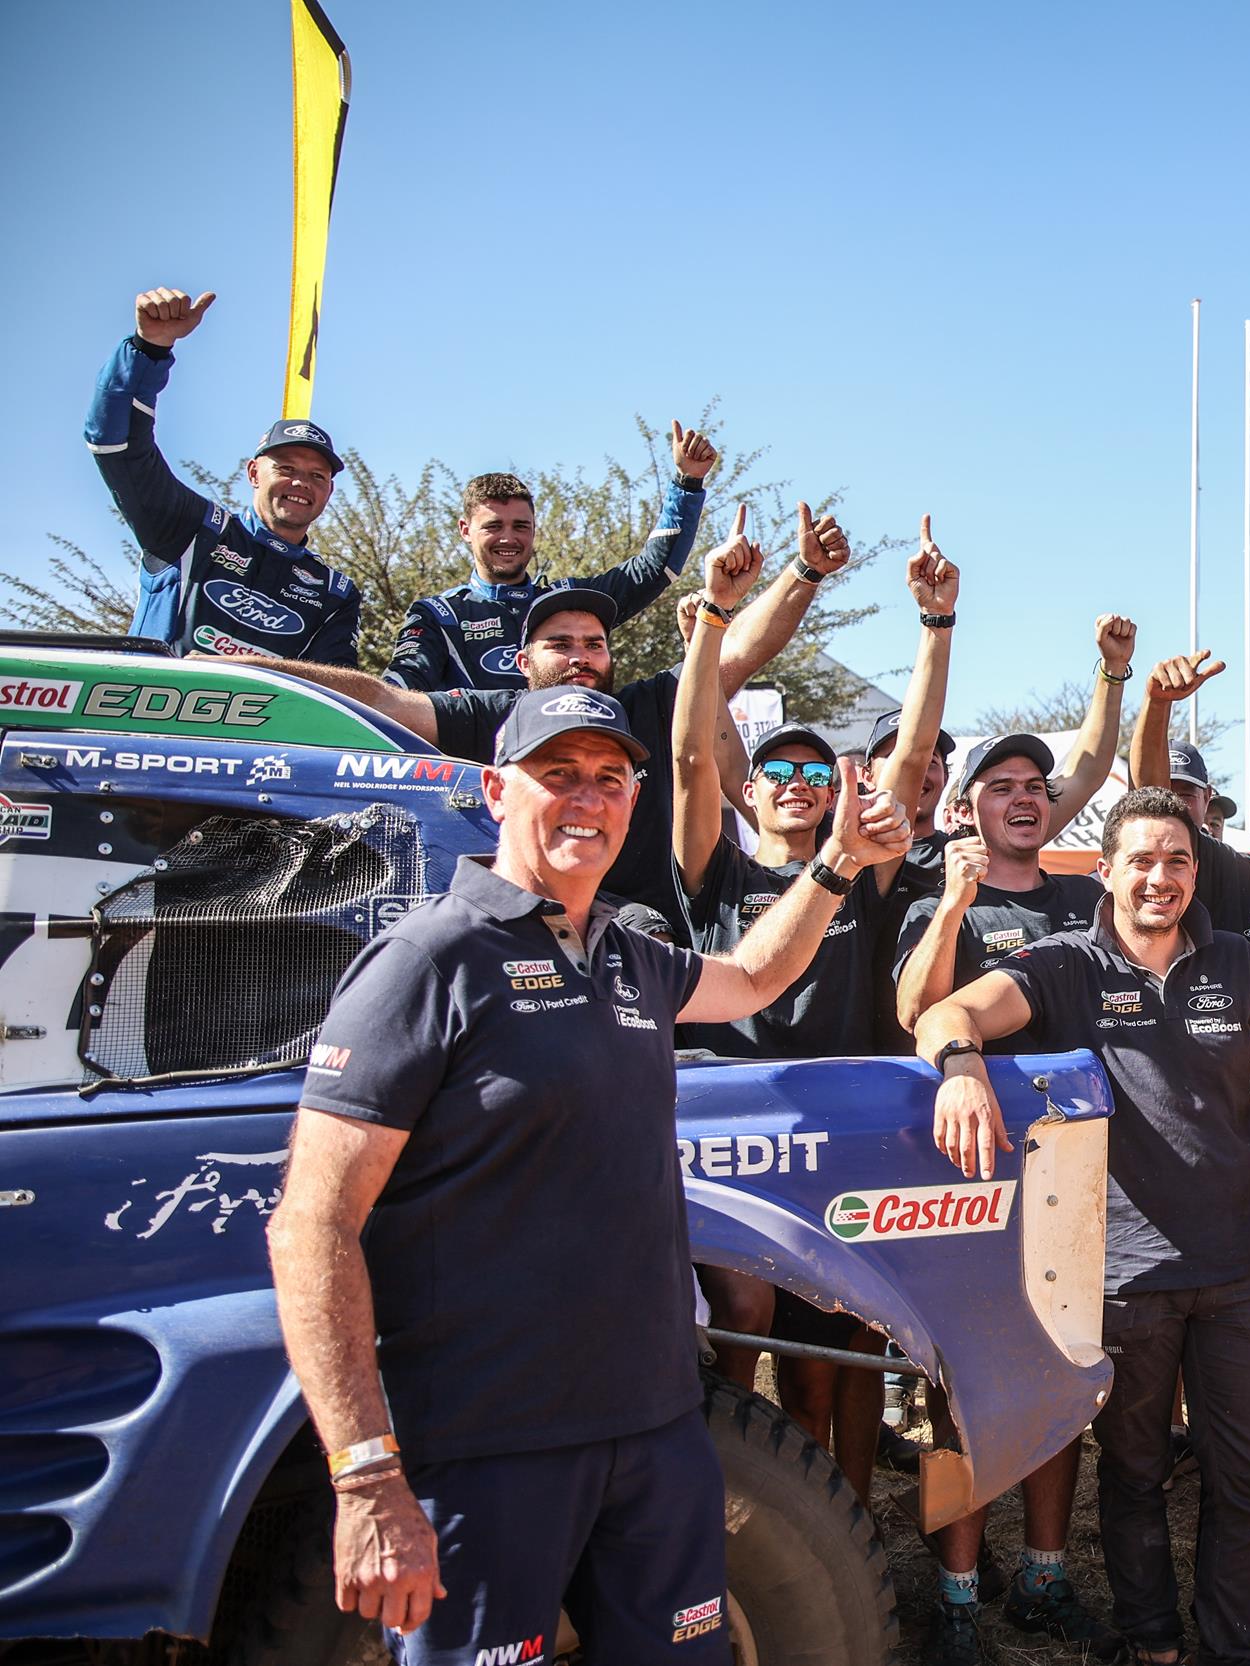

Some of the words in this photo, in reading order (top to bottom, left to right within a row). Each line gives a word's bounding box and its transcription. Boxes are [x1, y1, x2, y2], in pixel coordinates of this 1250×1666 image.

[279, 588, 299, 601] Ford
[219, 587, 289, 631] Ford
[469, 618, 501, 632] Castrol
[464, 628, 504, 642] EDGE
[82, 682, 279, 727] EDGE
[556, 696, 603, 716] Ford
[66, 749, 243, 776] M-SPORT
[336, 753, 454, 782] NWM
[334, 780, 351, 790] NEIL
[352, 781, 397, 791] WOOLRIDGE
[398, 783, 450, 793] MOTORSPORT
[823, 918, 858, 938] coBoost
[992, 930, 1021, 941] Castrol
[985, 937, 1026, 953] EDGE
[516, 961, 553, 976] Castrol
[511, 974, 565, 991] EDGE
[1189, 982, 1223, 992] SAPPHIRE
[514, 1000, 540, 1011] Ford
[545, 999, 565, 1011] Ford
[565, 994, 589, 1008] Credit
[1108, 992, 1139, 1004] Castrol
[1198, 995, 1226, 1009] Ford
[1102, 1001, 1143, 1014] EDGE
[619, 1012, 658, 1031] EcoBoost
[1138, 1017, 1157, 1028] Credit
[1190, 1018, 1212, 1027] Powered
[1190, 1021, 1242, 1035] EcoBoost
[872, 1187, 1002, 1234] Castrol
[685, 1598, 720, 1623] Castrol
[671, 1613, 723, 1644] EDGE
[474, 1634, 544, 1666] NWM
